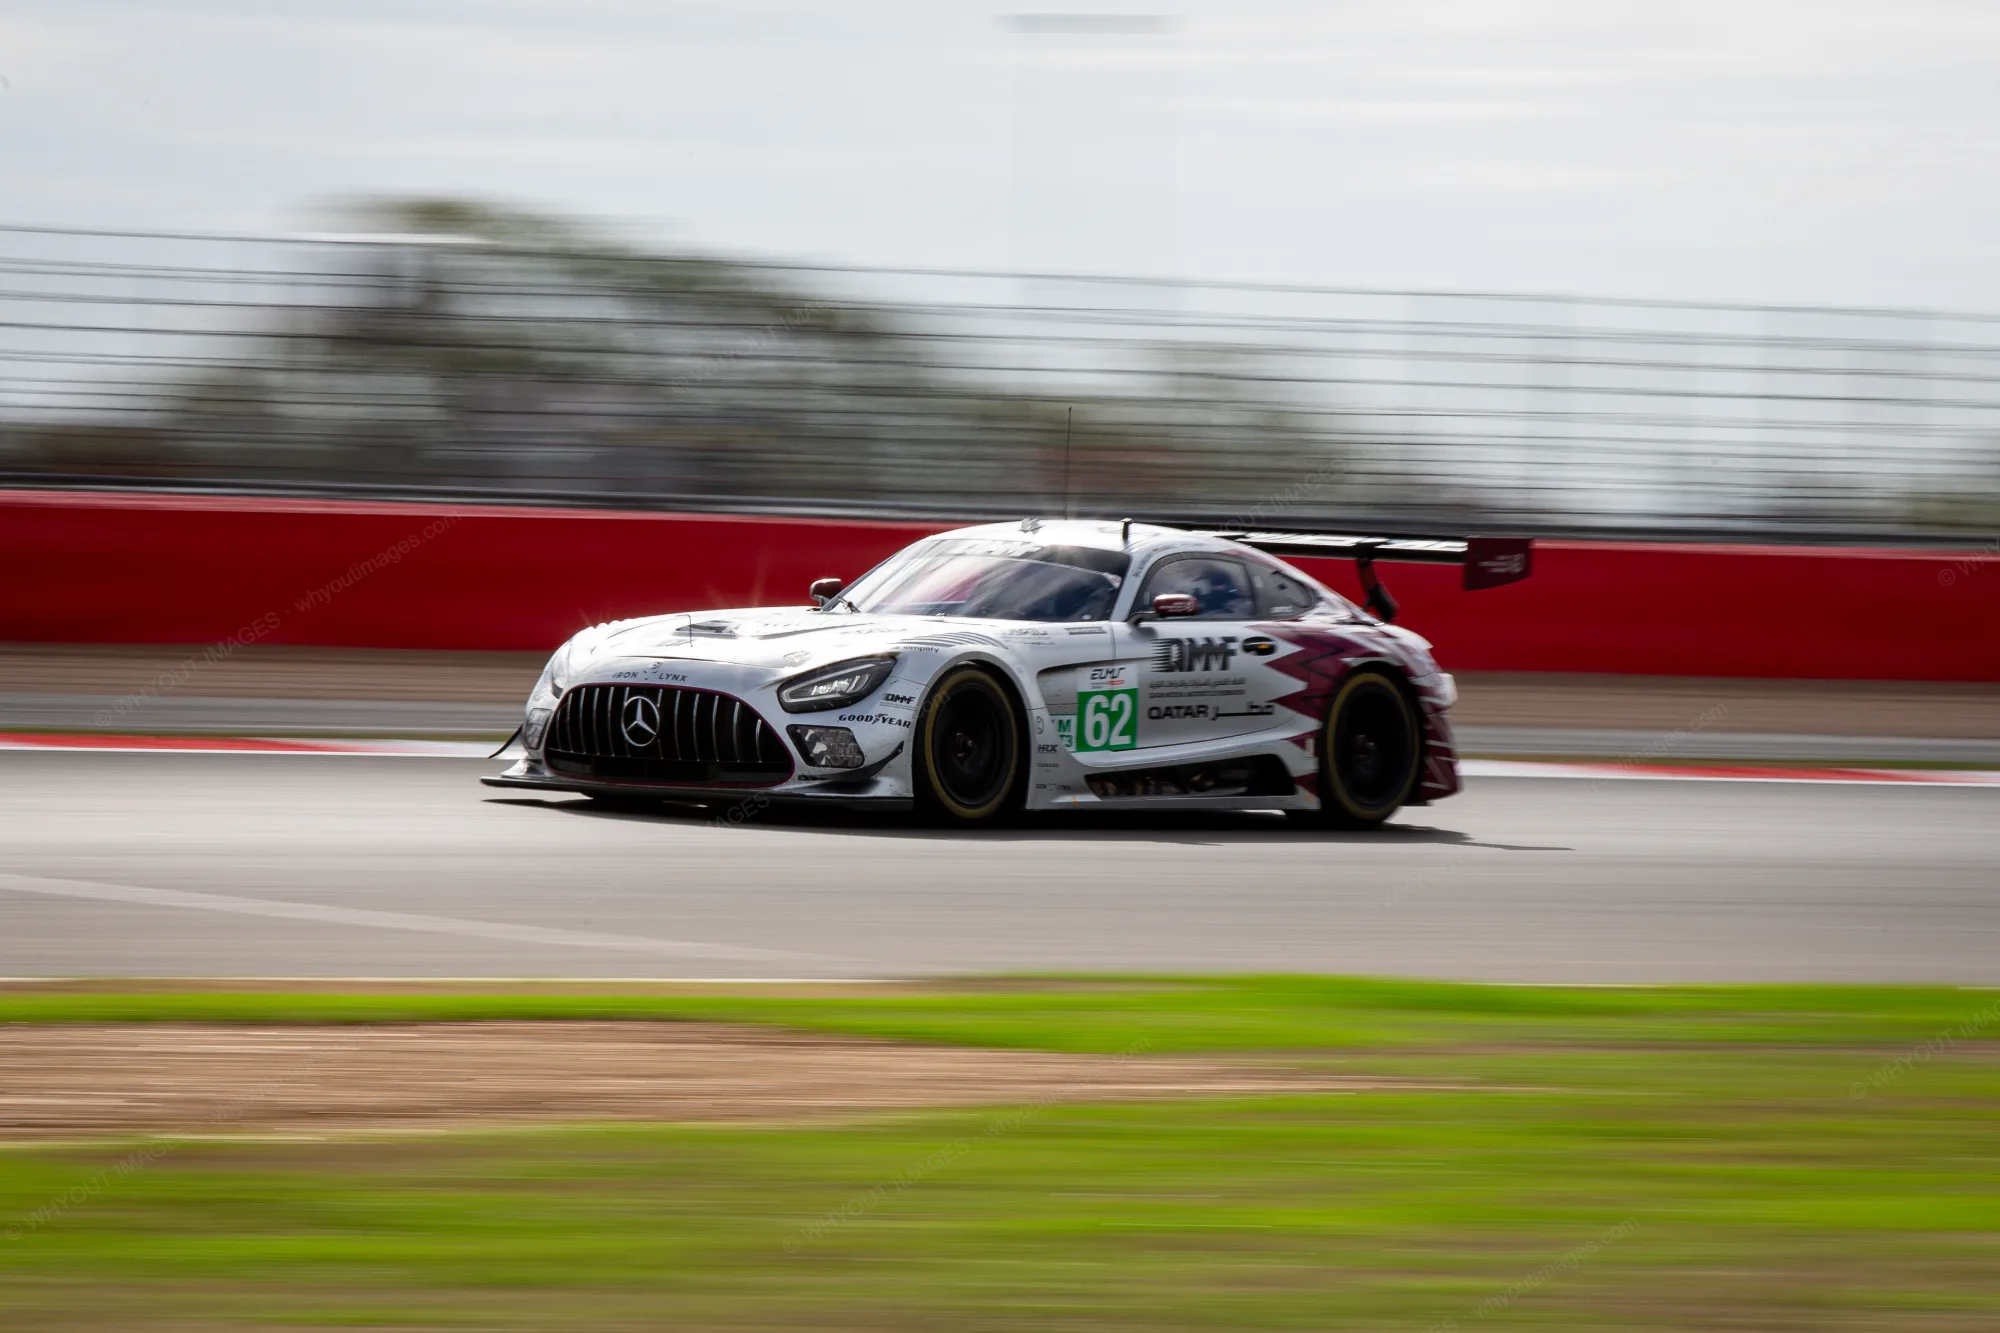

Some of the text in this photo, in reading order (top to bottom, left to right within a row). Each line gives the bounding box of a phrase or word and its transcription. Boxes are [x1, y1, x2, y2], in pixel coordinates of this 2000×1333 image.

[903, 645, 940, 654] simplify
[1150, 636, 1239, 672] QMMF
[612, 671, 688, 682] IRON LYNX
[1147, 704, 1209, 719] QATAR
[1058, 719, 1072, 733] M
[1084, 693, 1133, 747] 62
[1060, 734, 1074, 748] T3
